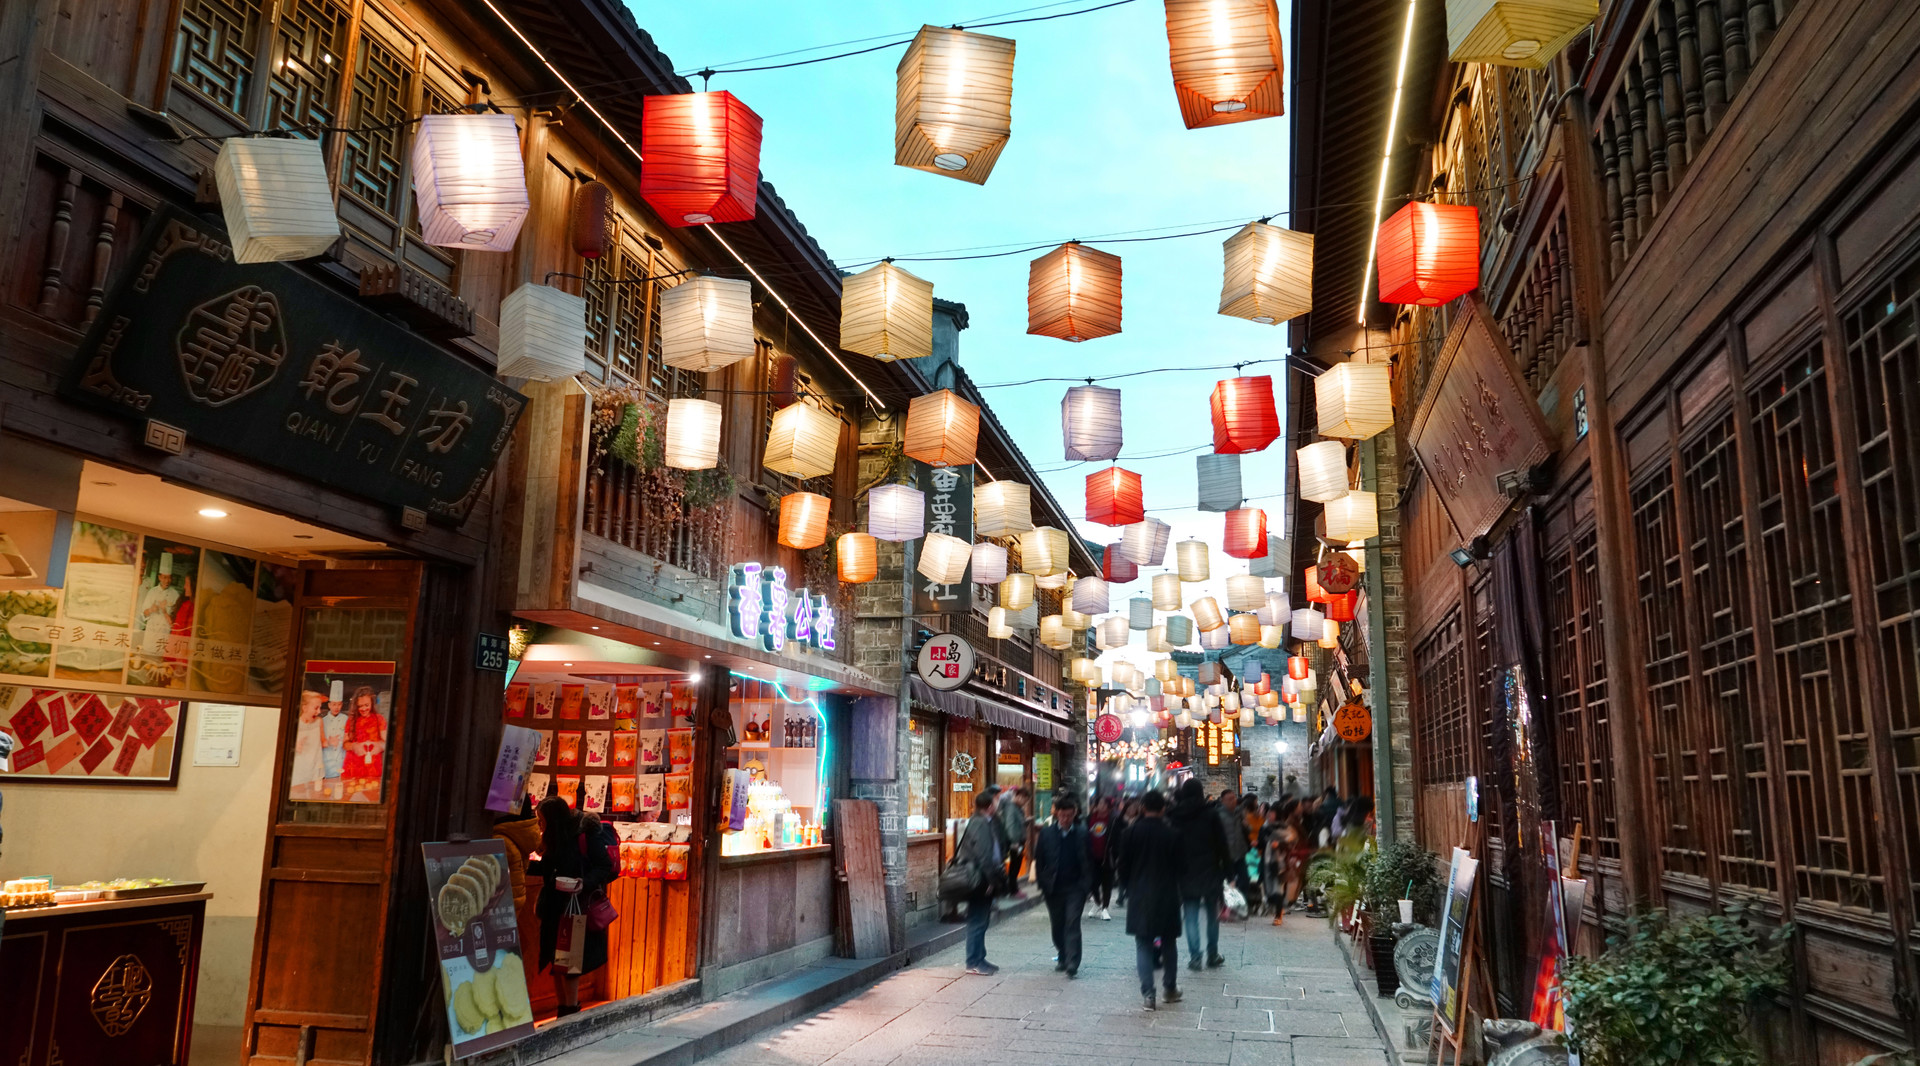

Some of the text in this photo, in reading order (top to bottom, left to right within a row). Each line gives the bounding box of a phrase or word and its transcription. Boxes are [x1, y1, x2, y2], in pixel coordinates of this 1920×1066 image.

[299, 339, 473, 454] 乾玉坊
[285, 411, 444, 489] QIAN YU FANG
[732, 562, 835, 651] 番薯公社
[482, 650, 503, 668] 255
[928, 664, 957, 679] 人家
